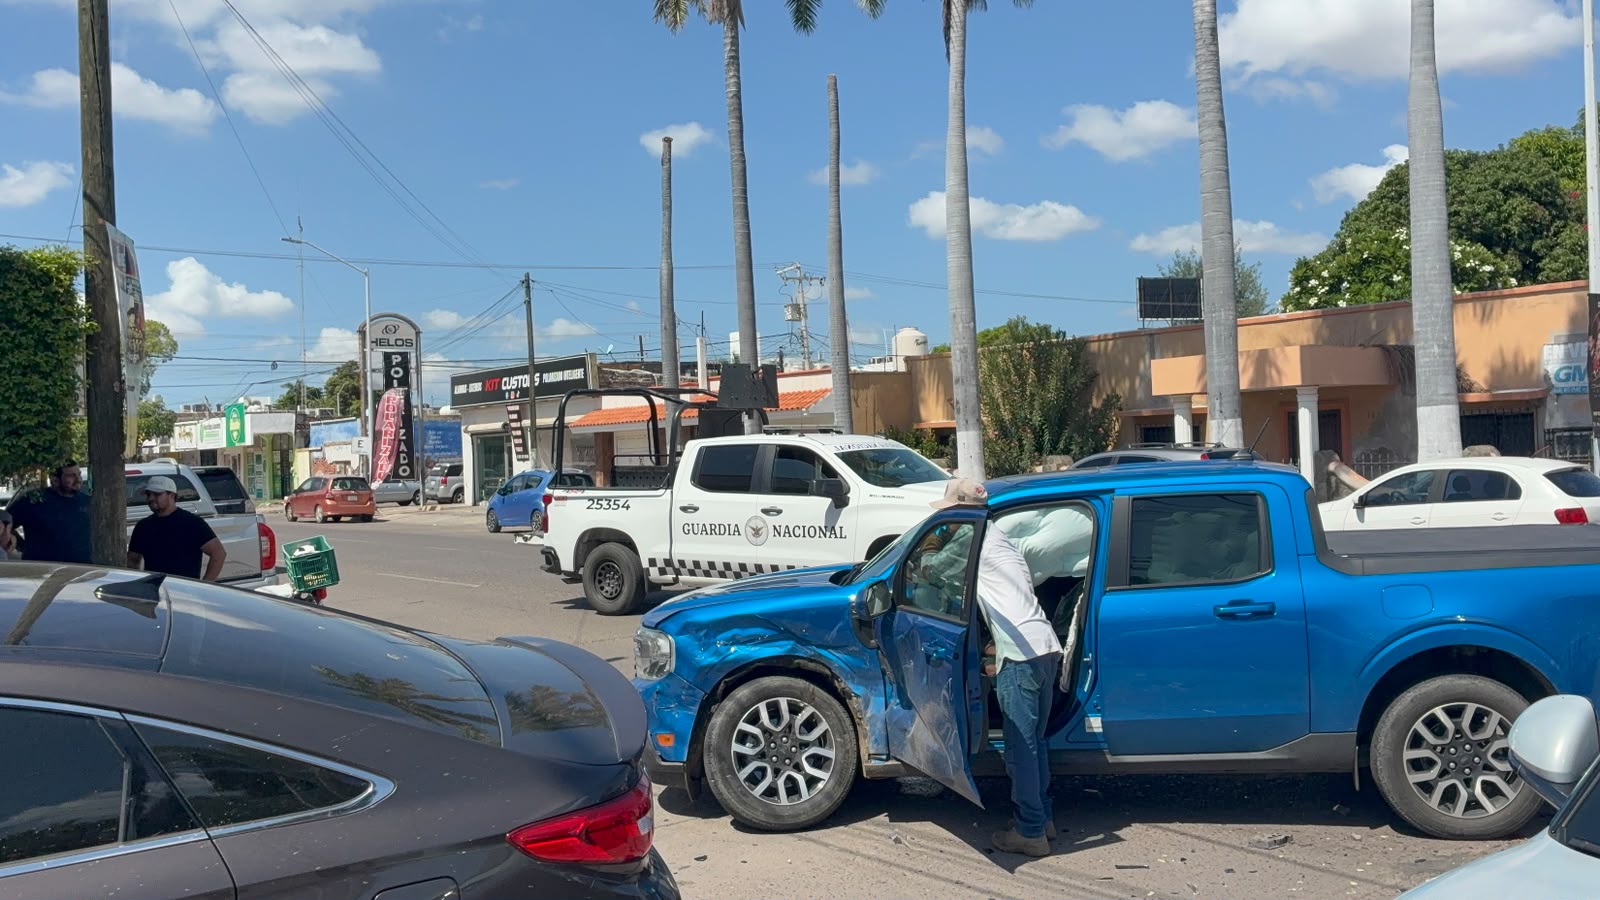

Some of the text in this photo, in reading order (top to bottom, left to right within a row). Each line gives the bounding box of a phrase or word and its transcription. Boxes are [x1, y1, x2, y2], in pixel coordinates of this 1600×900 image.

[485, 378, 501, 391] KIT
[501, 373, 541, 390] CUSTOS
[357, 439, 364, 448] E
[586, 498, 631, 511] 25354
[682, 523, 847, 539] GUARDIA NACIONAL
